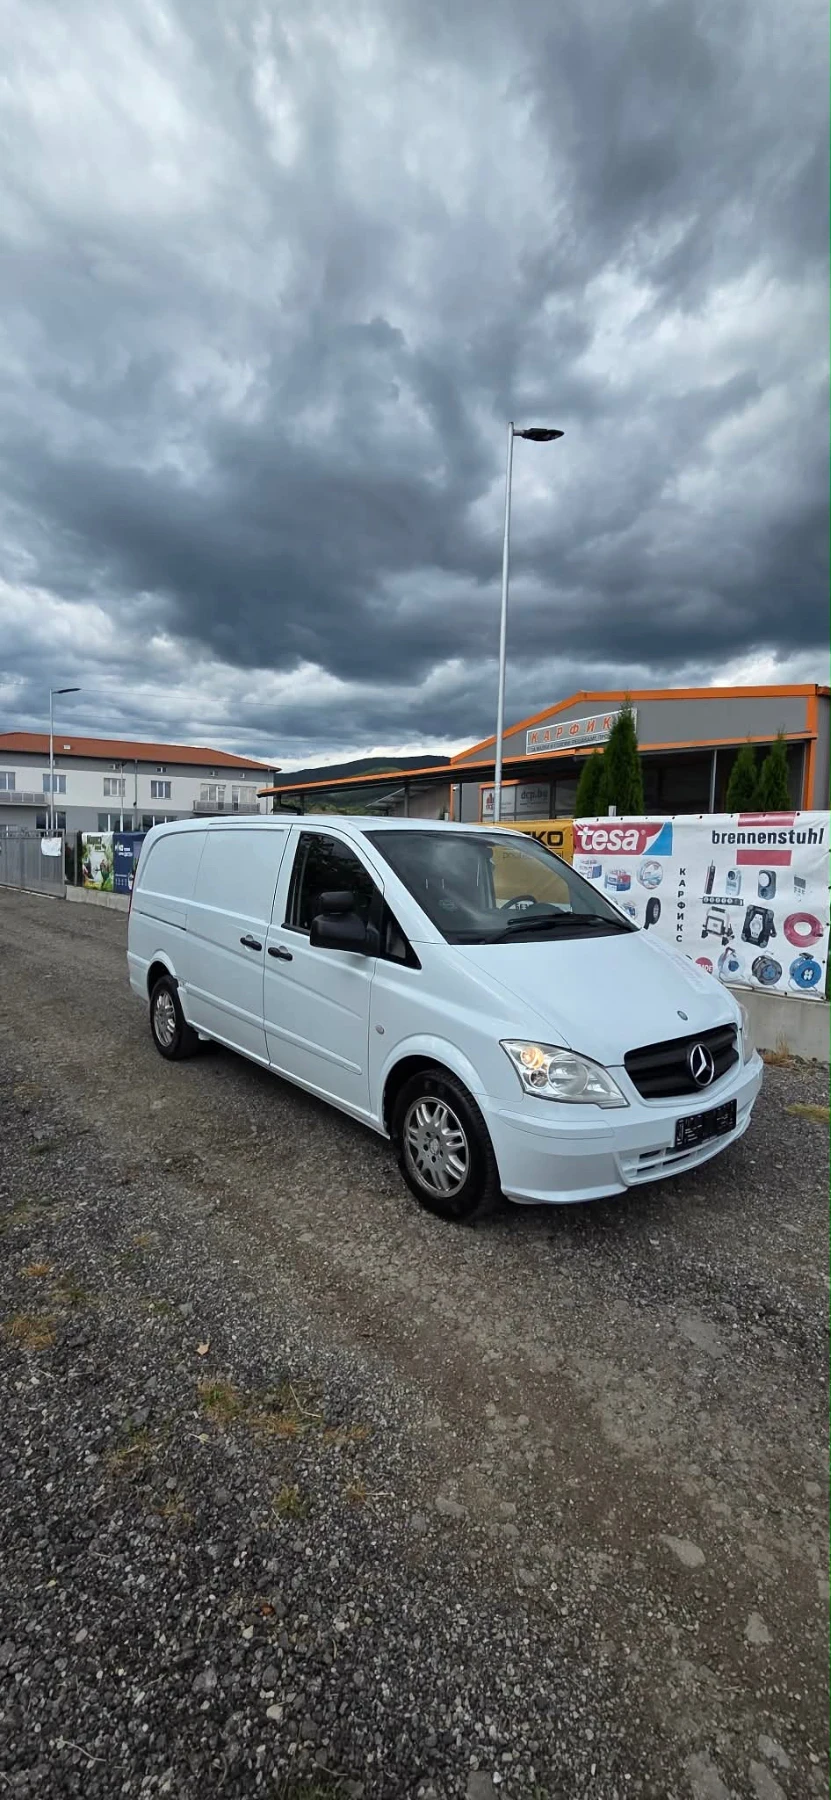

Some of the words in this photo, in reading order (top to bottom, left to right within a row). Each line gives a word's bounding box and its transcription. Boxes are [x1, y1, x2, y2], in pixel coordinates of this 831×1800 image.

[531, 716, 612, 744] КАРФИК
[521, 831, 564, 847] KO
[577, 826, 639, 851] tesa
[711, 827, 825, 845] brennenstuhl
[675, 867, 687, 943] КАРФИКС
